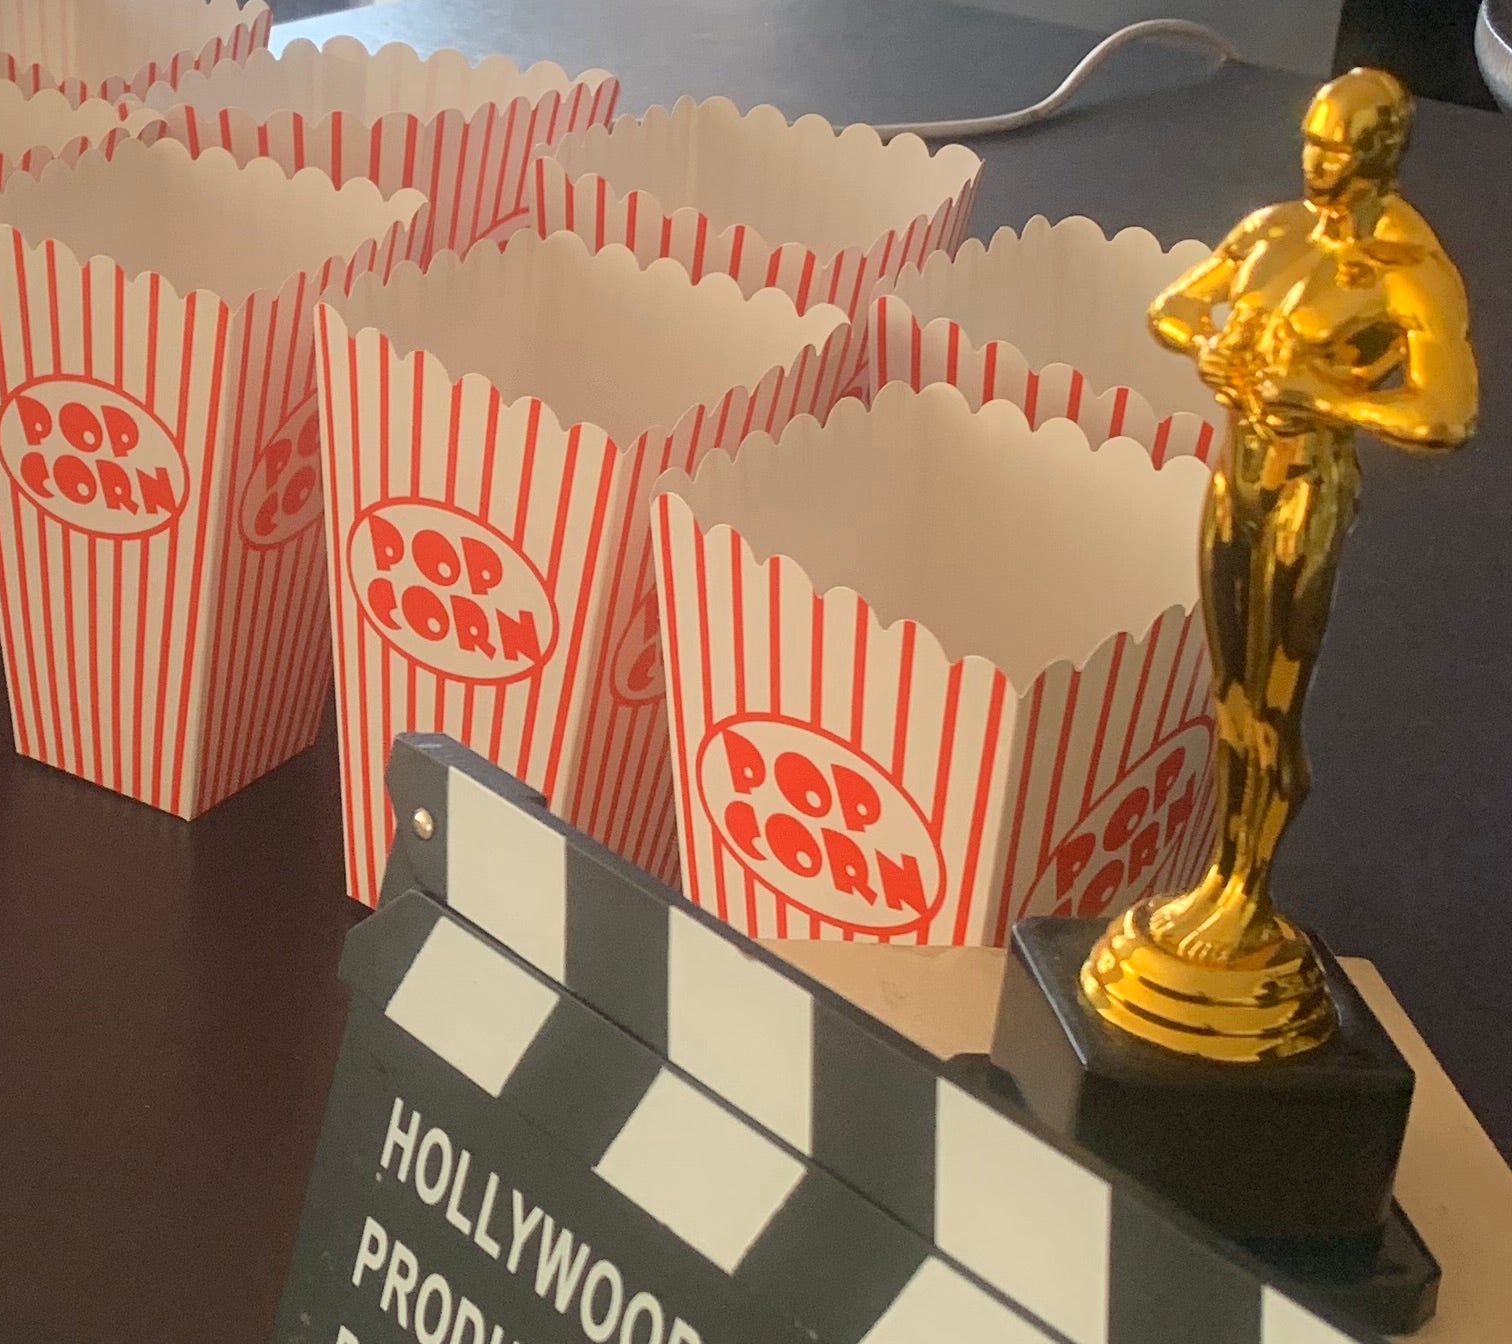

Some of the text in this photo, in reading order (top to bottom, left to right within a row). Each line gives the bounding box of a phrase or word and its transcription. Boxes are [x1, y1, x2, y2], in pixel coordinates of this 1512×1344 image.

[15, 394, 140, 458] POP
[263, 414, 321, 490] PO
[19, 450, 178, 516] CORN
[368, 513, 504, 596] POP
[367, 576, 543, 662] CORN
[721, 728, 882, 833] POP
[723, 800, 929, 916] CORN
[1054, 746, 1187, 902] POP
